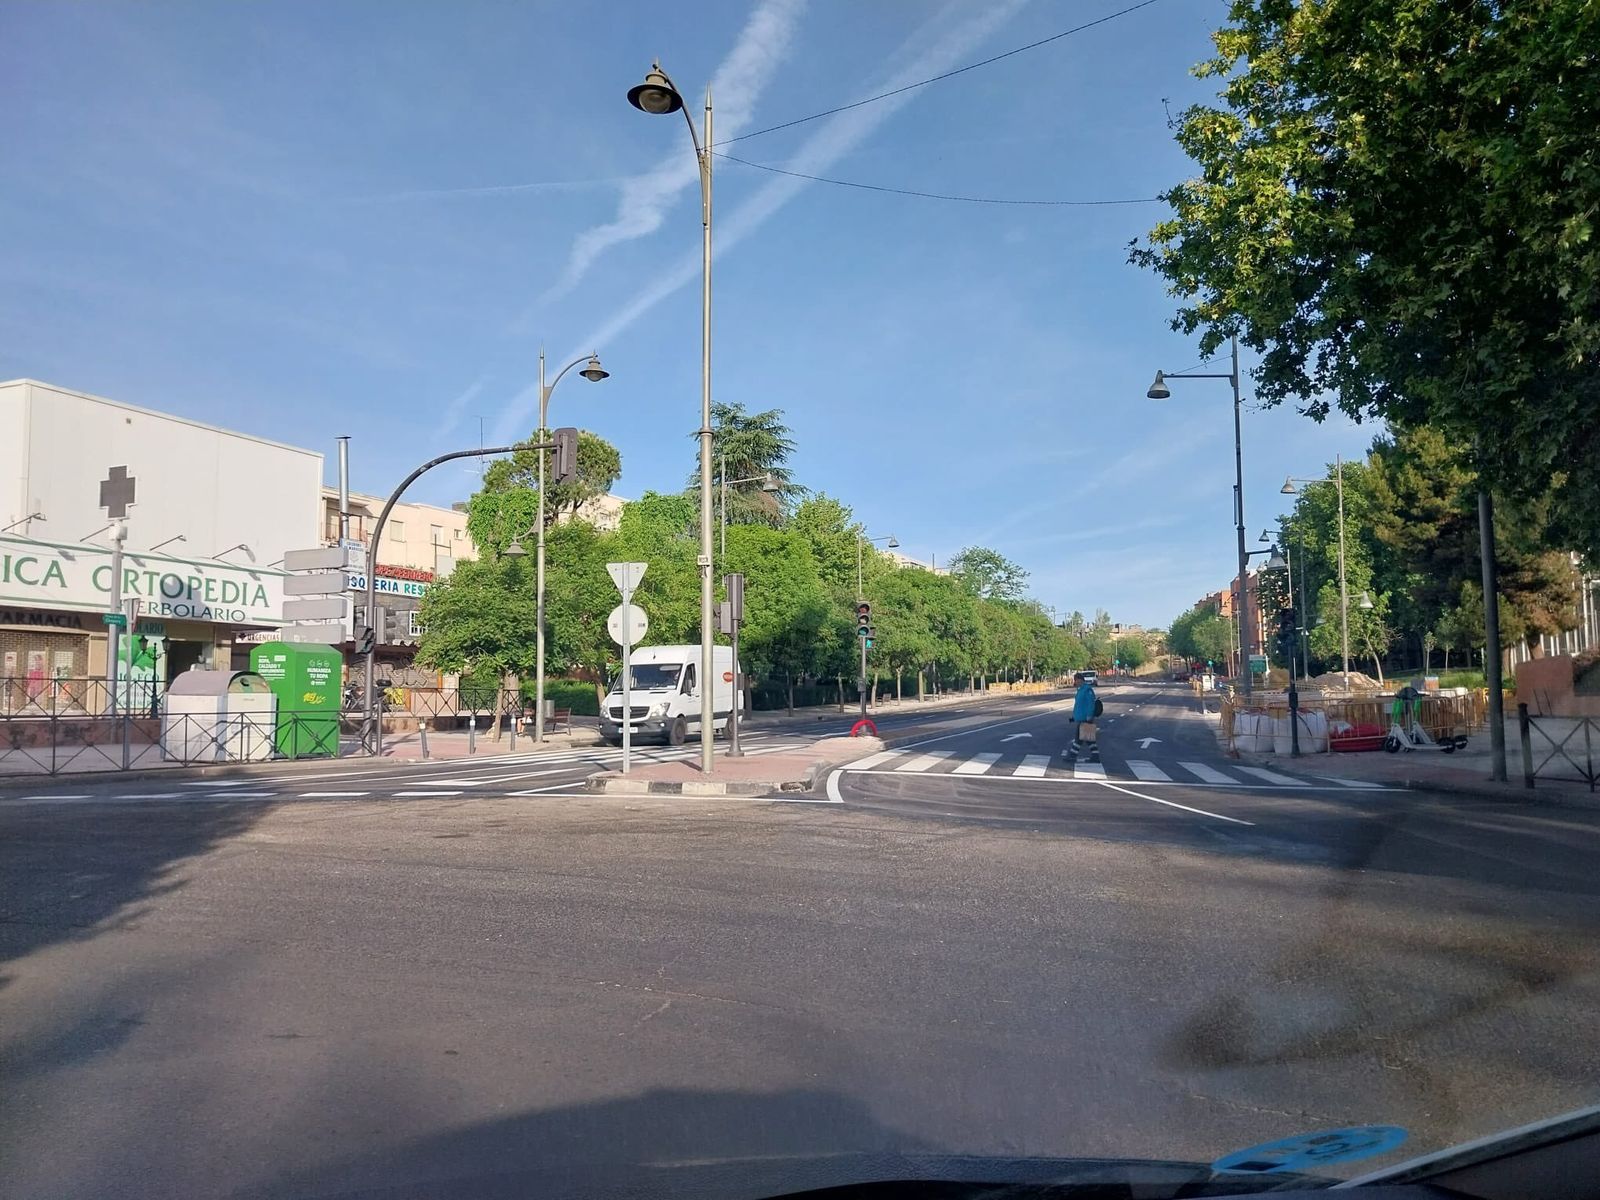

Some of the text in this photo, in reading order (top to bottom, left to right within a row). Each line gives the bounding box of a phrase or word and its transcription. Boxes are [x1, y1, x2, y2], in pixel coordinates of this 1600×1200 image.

[92, 565, 270, 608] ORTOPEDIA
[0, 610, 82, 628] ARMACIA
[137, 601, 246, 622] ERBOLARIO
[247, 632, 280, 642] URGENCIAS
